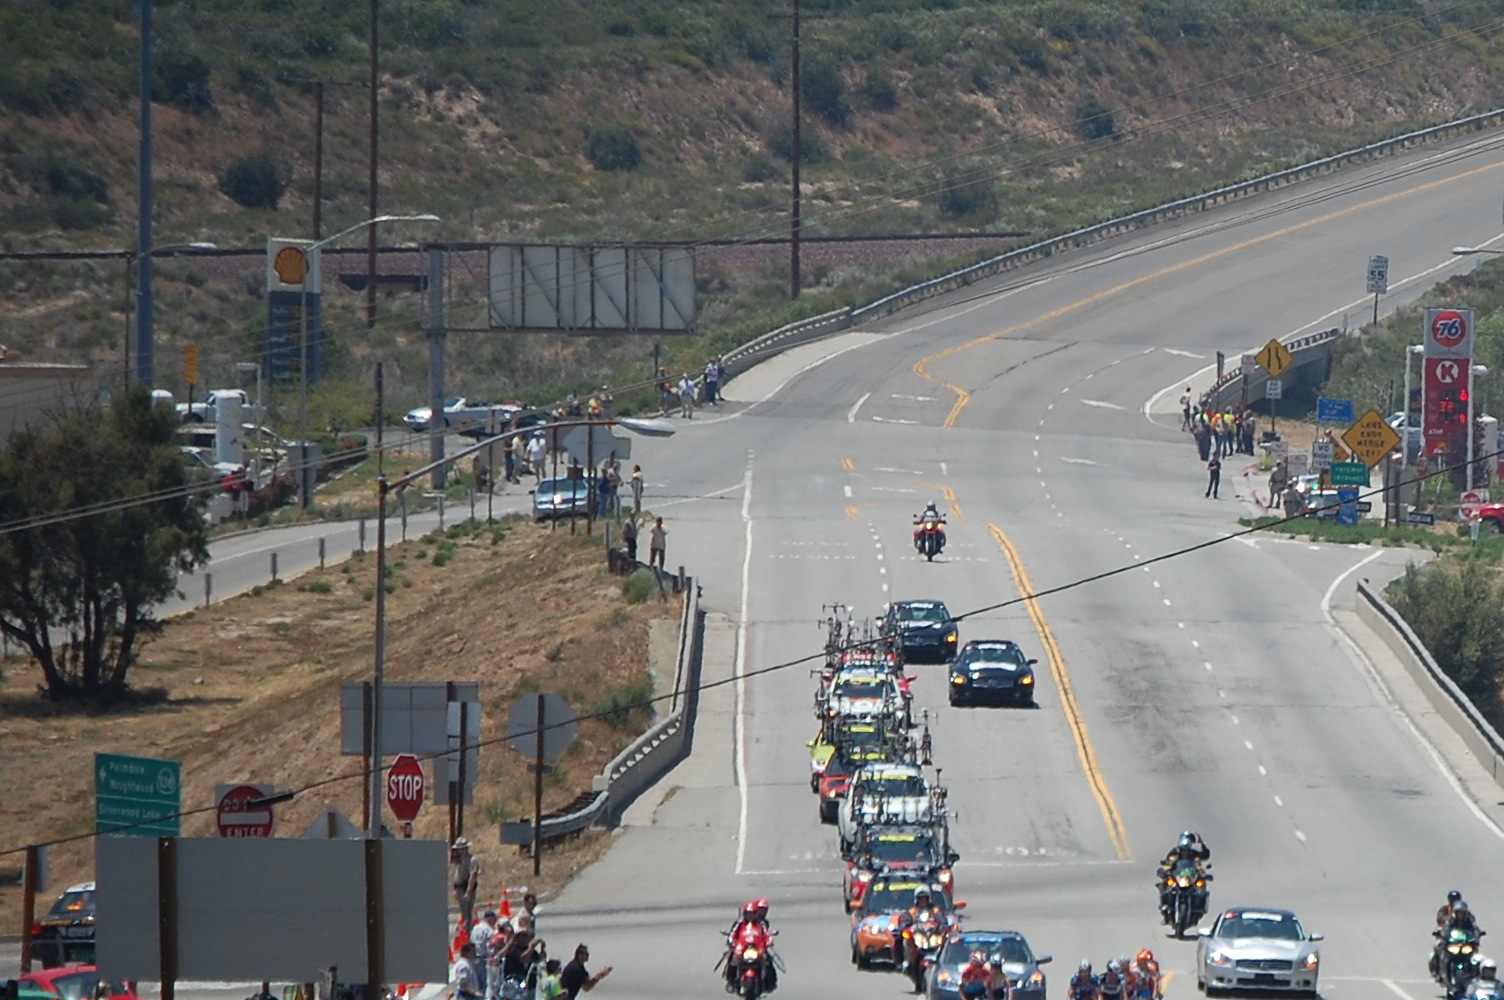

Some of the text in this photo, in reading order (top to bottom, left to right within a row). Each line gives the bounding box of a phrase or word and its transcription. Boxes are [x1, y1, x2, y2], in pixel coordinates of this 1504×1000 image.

[1370, 270, 1385, 281] 55
[1437, 318, 1460, 338] 76
[389, 774, 422, 801] STOP
[226, 827, 265, 839] ENTER
